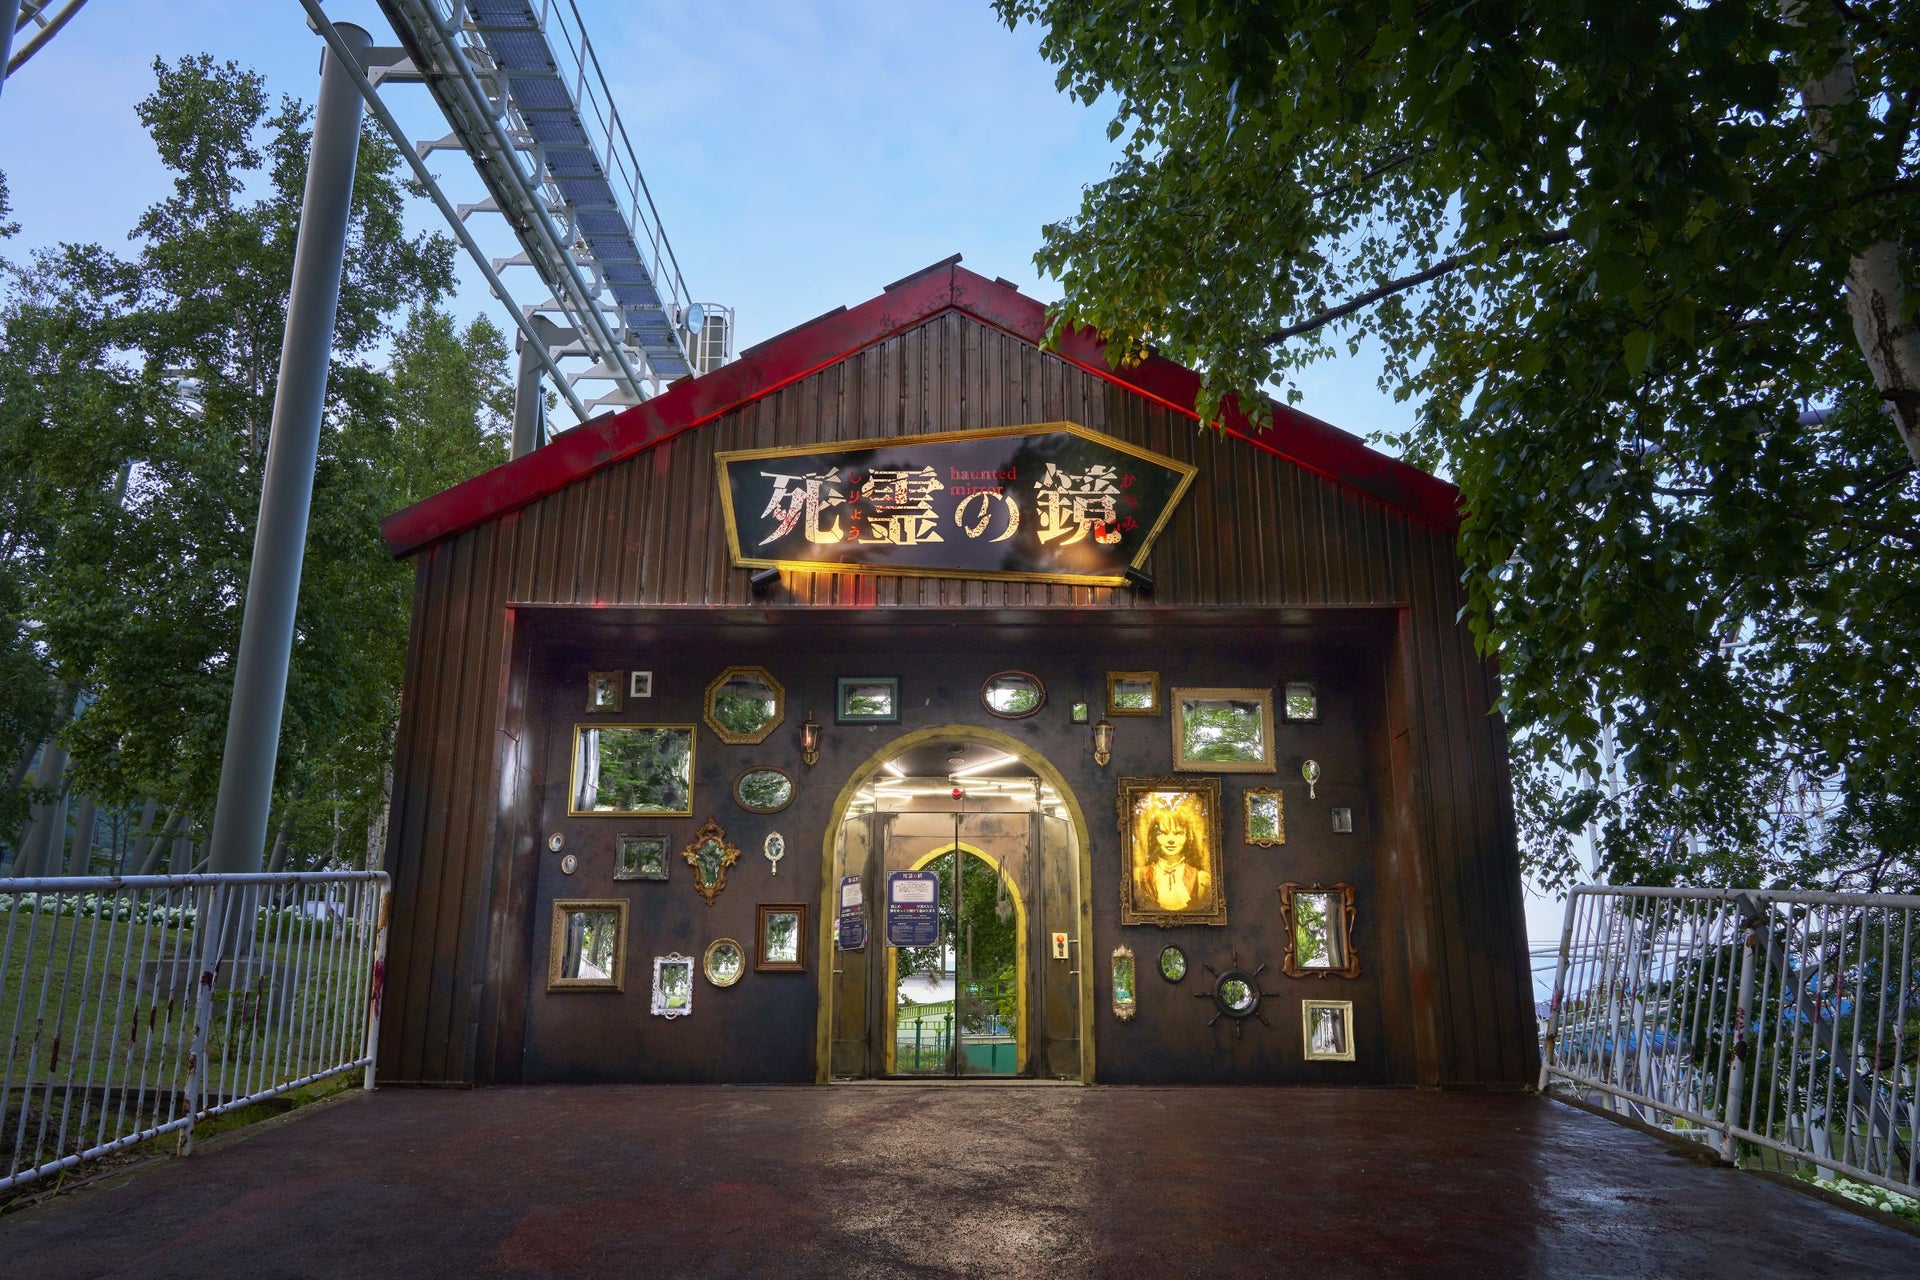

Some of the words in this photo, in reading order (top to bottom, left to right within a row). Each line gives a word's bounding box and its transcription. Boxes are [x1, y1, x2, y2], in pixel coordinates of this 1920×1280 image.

[950, 465, 1017, 480] haunted
[950, 482, 1004, 496] mirror
[758, 462, 1122, 546] 死霊の鏡
[847, 471, 862, 541] しりょう
